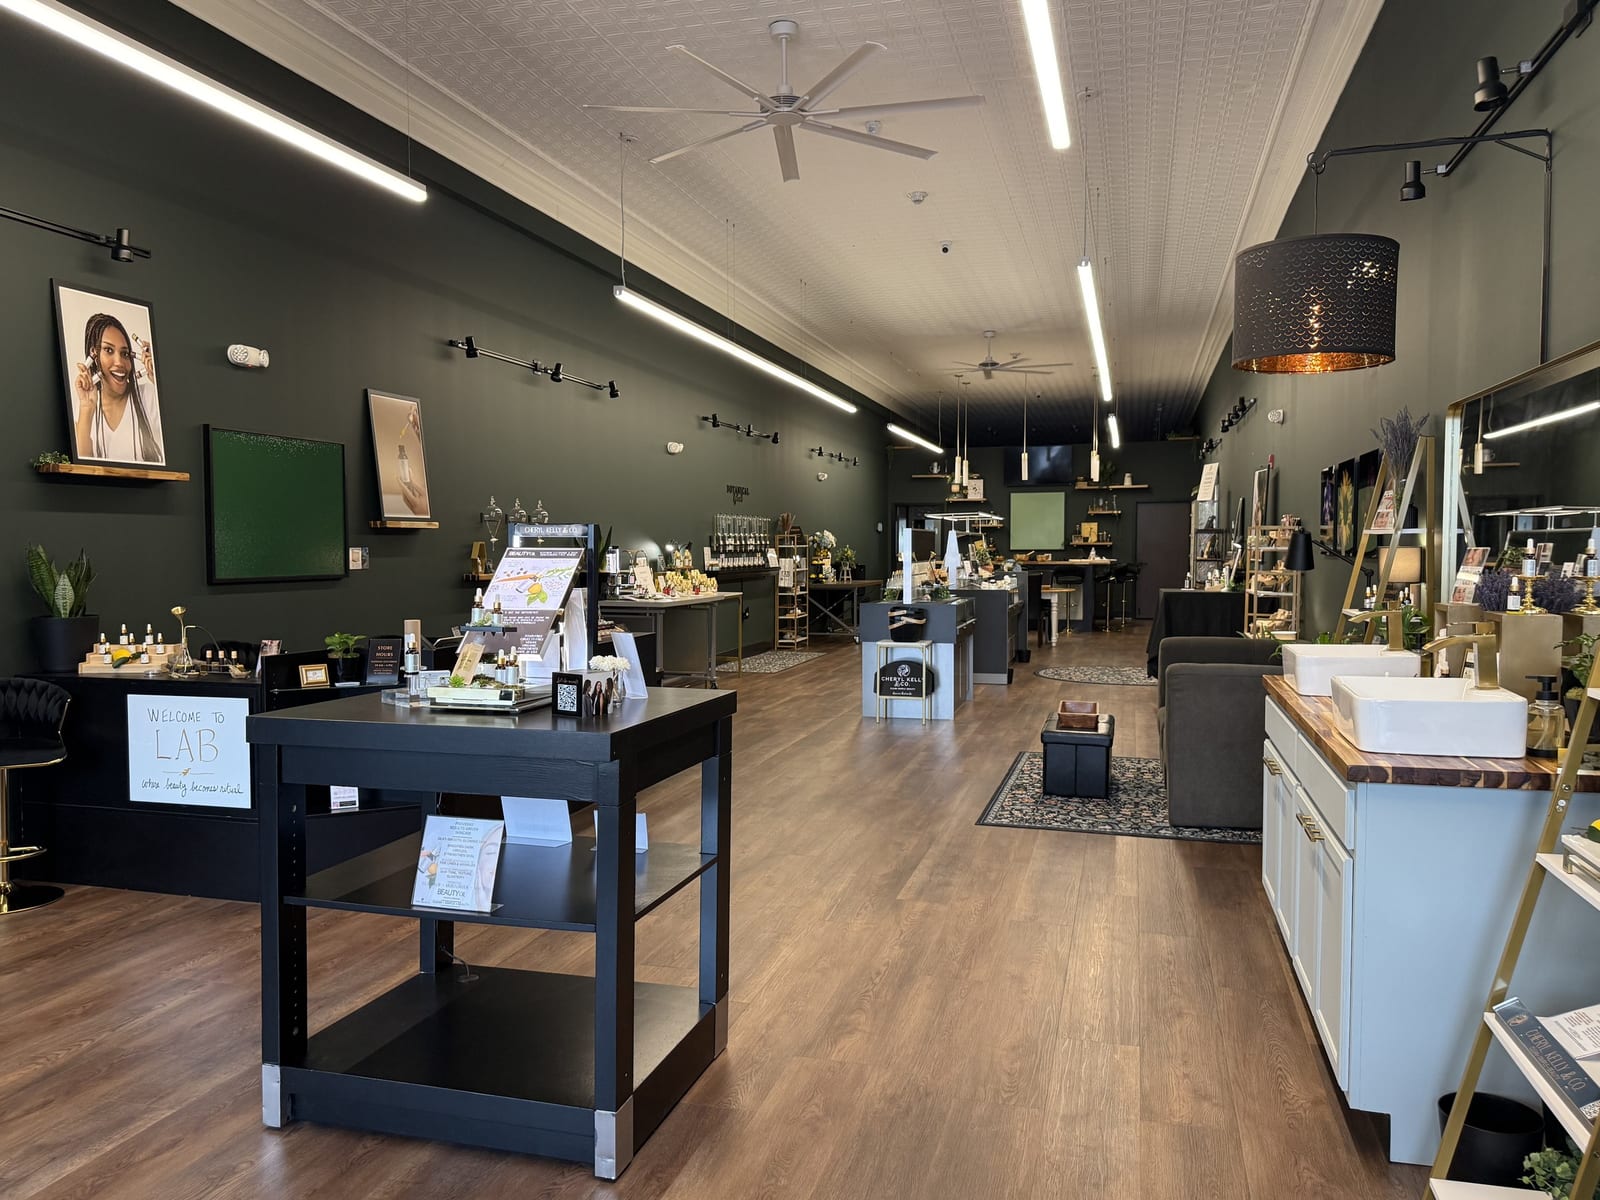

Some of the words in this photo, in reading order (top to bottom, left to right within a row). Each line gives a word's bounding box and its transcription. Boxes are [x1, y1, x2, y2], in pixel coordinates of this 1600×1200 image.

[147, 707, 201, 723] WELCOME
[212, 711, 225, 724] TO
[155, 728, 219, 763] LAB
[141, 778, 160, 789] where
[164, 778, 187, 798] beauty
[190, 781, 218, 792] becomes
[219, 783, 244, 795] ritual
[1525, 1028, 1552, 1054] CHERYL
[1544, 1050, 1571, 1072] KELLY
